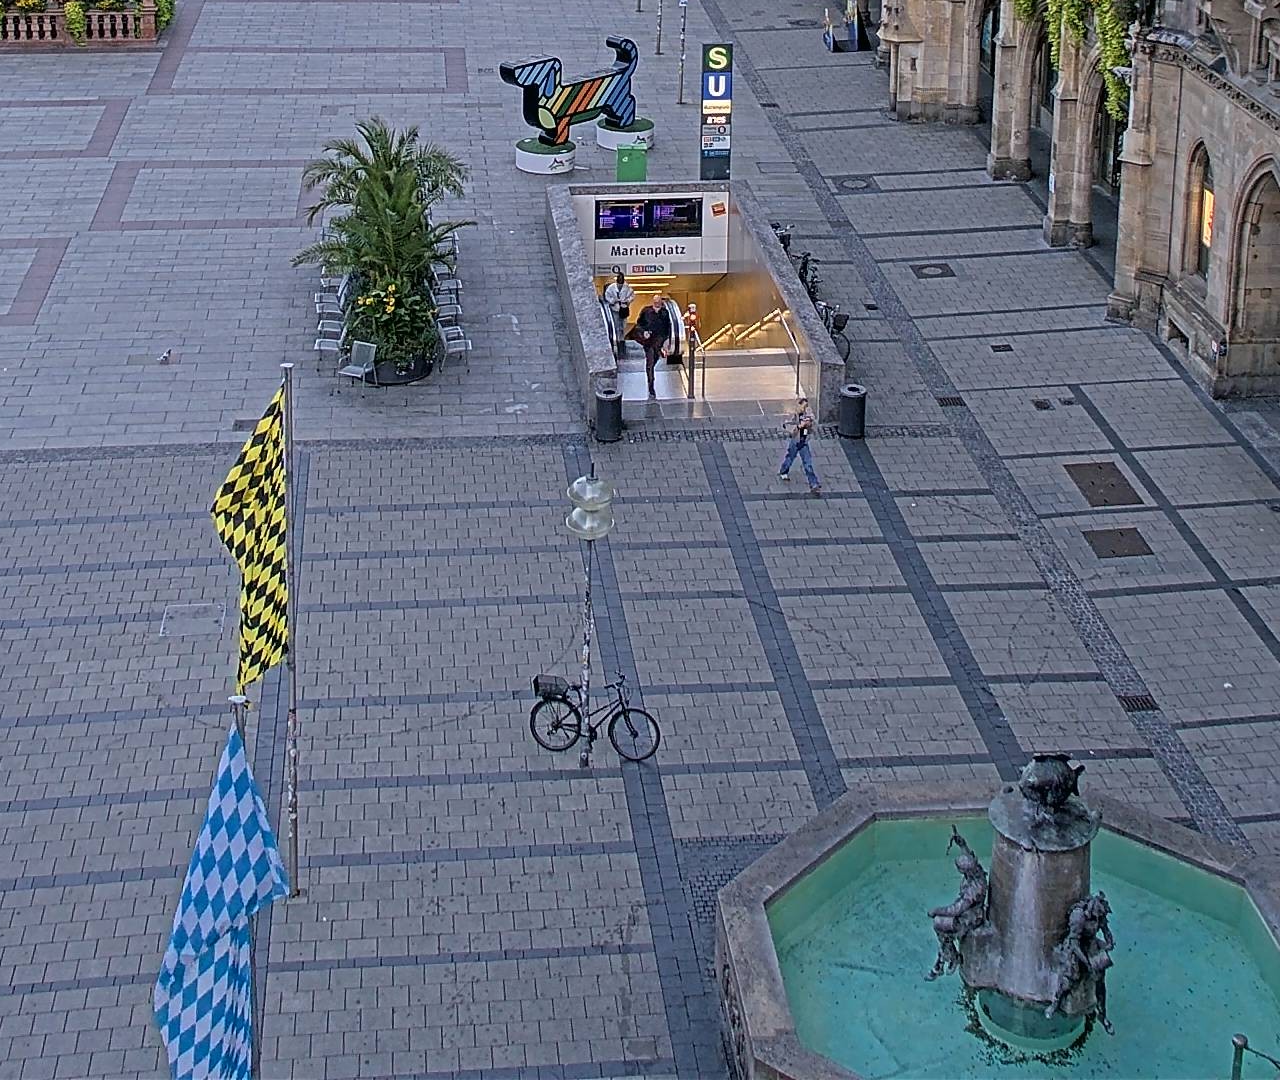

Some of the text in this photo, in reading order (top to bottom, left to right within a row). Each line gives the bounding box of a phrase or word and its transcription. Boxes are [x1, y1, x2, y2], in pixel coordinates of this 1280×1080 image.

[708, 46, 728, 69] S
[708, 75, 726, 97] U
[611, 244, 686, 258] Marienplatz
